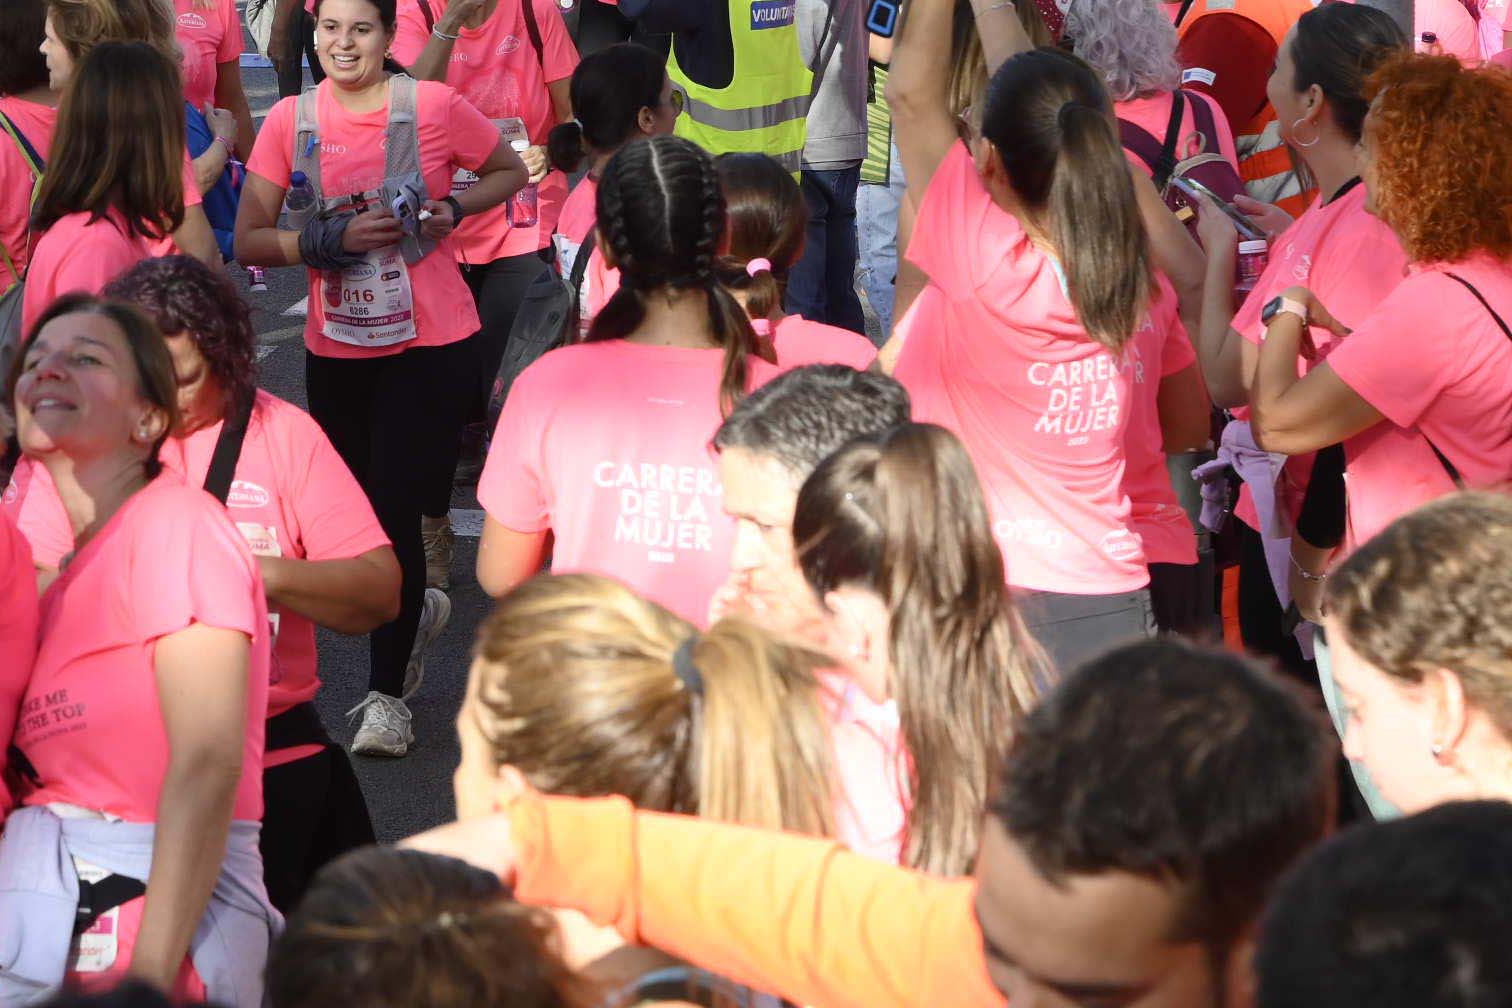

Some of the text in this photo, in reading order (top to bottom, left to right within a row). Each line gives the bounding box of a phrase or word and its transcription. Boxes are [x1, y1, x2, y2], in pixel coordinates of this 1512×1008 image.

[343, 288, 375, 303] 016
[1047, 380, 1118, 412] DE LA
[1034, 405, 1121, 435] MUJER
[621, 488, 707, 522] DE LA
[614, 514, 713, 552] MUJER
[52, 703, 86, 721] TOP
